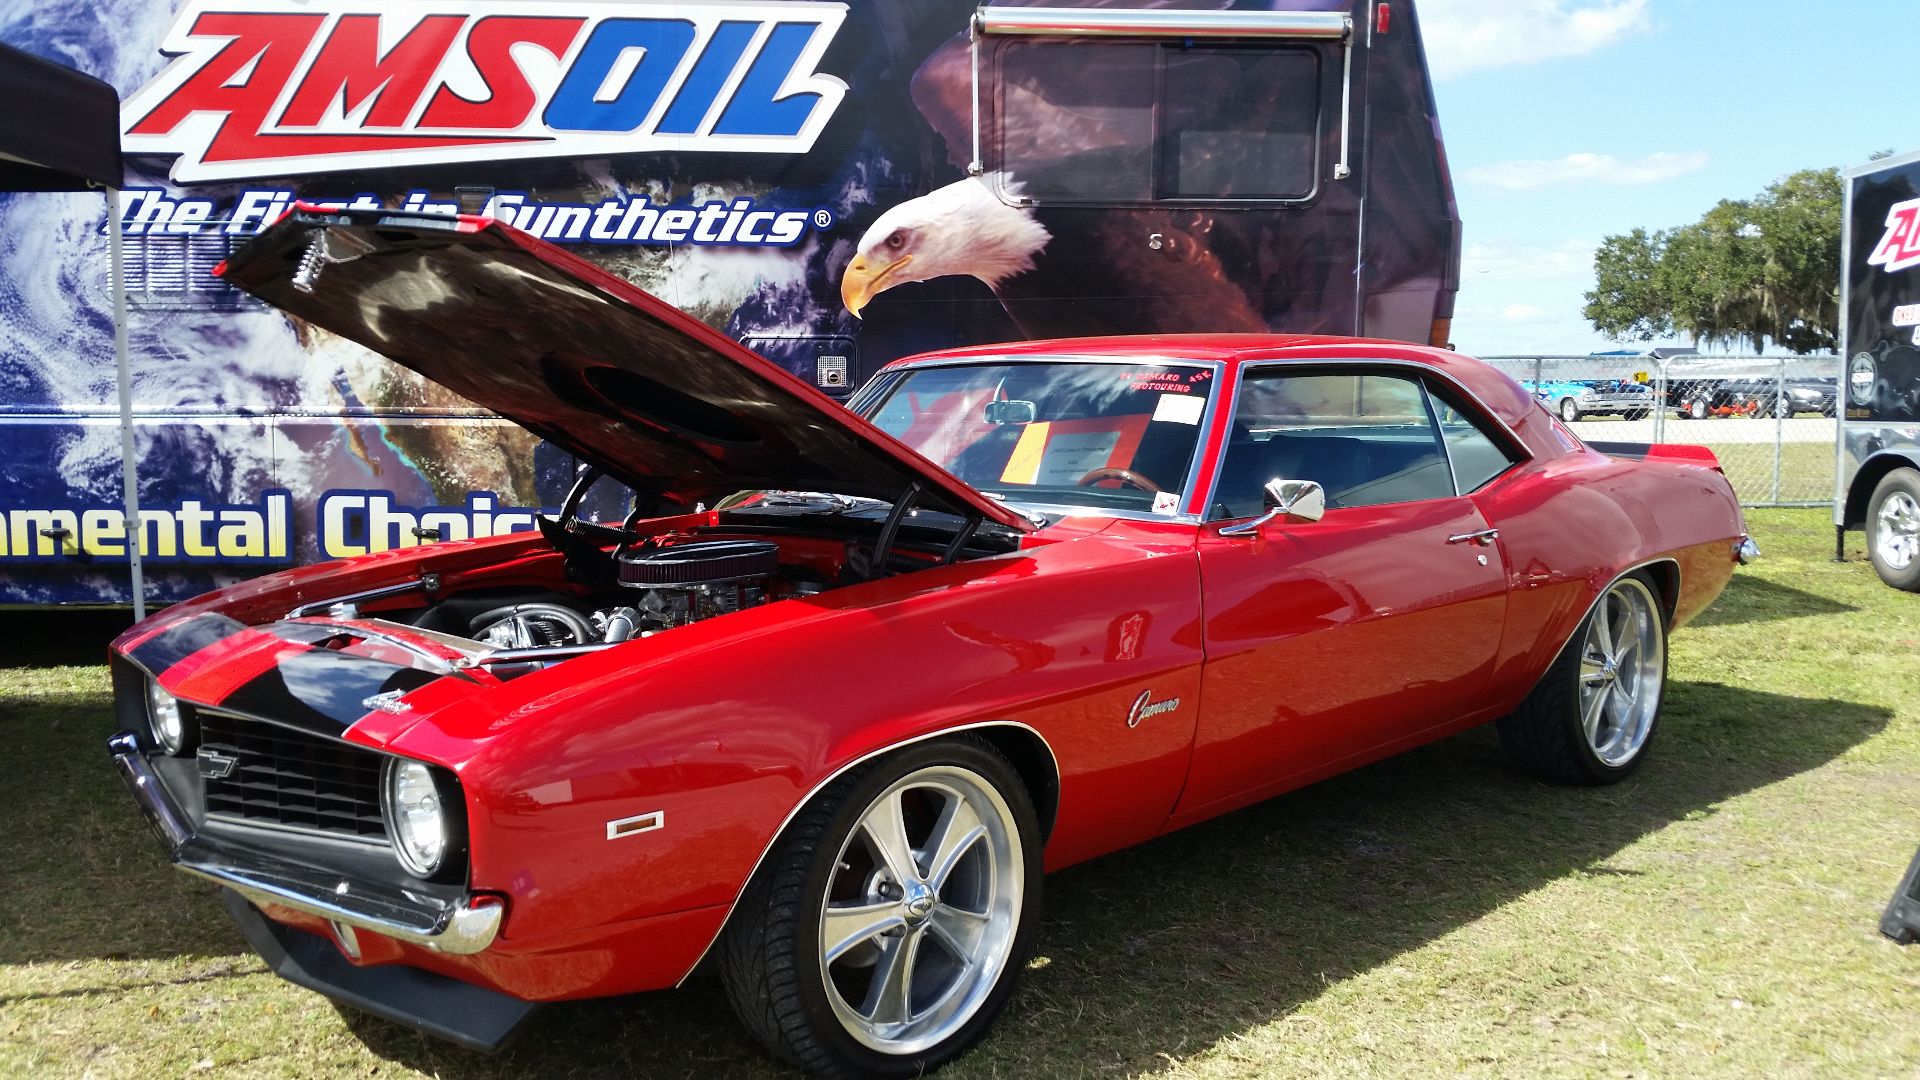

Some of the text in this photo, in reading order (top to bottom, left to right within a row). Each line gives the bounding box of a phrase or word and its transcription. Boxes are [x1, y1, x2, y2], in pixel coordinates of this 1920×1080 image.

[126, 14, 820, 163] AMSOIL
[102, 191, 212, 233] The
[0, 495, 560, 558] mental Choi
